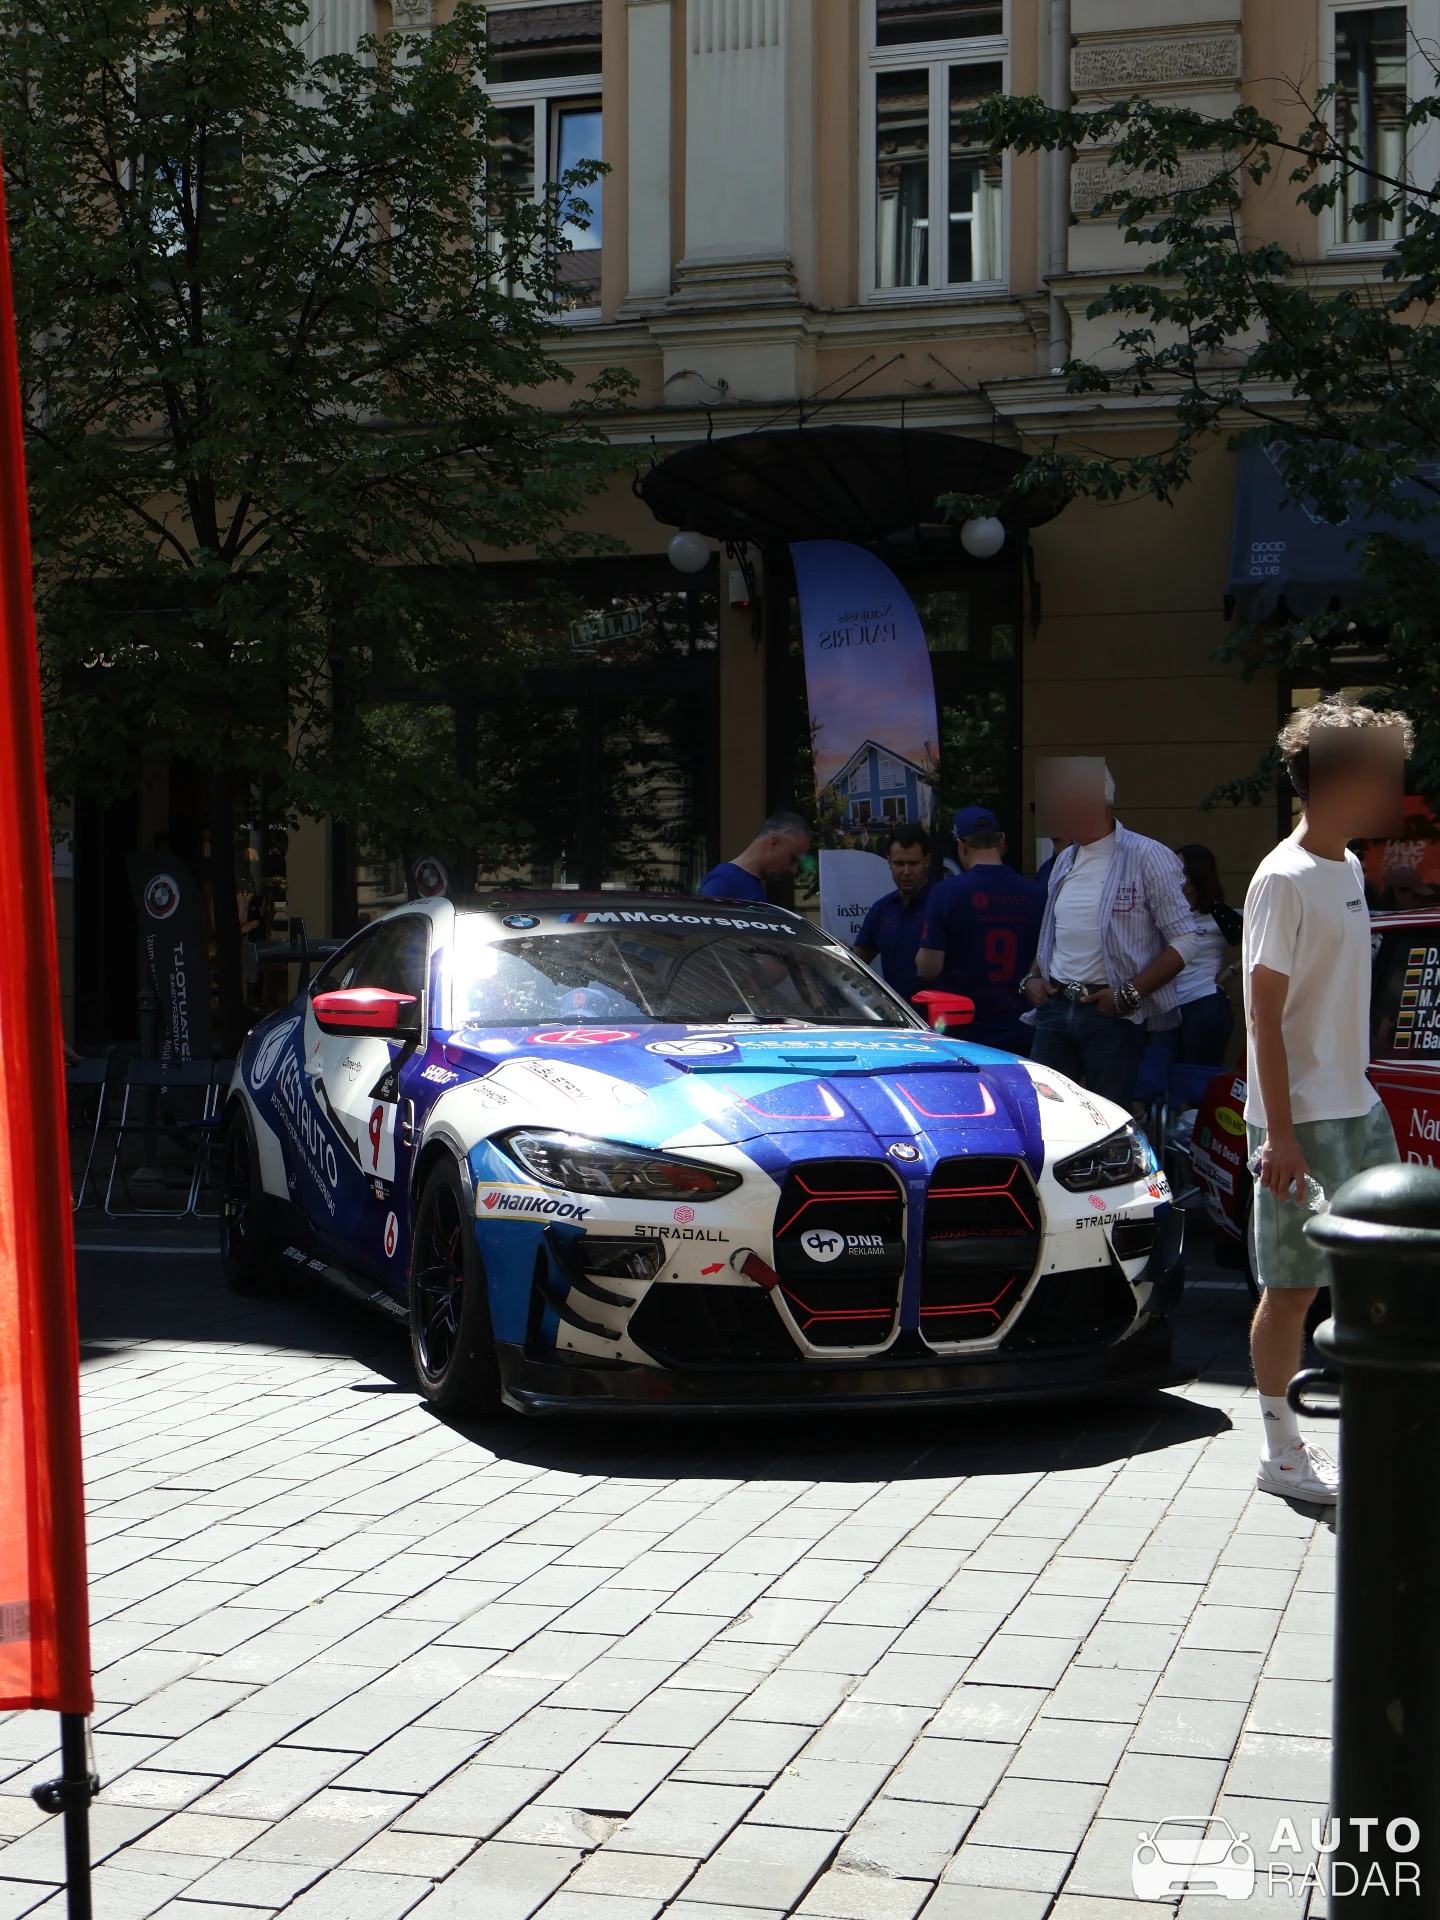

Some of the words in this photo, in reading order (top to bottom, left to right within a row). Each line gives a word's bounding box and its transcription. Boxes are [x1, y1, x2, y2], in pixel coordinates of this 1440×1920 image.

[1251, 541, 1287, 552] GOOD
[1251, 553, 1281, 564] LUCK
[1250, 565, 1280, 576] CLUB
[620, 911, 797, 935] Motorsport
[984, 928, 1018, 982] 9
[572, 993, 586, 1009] 9
[276, 1043, 338, 1188] KESTAUTO
[368, 1105, 384, 1172] 9
[1076, 1212, 1131, 1229] STRADALL
[386, 1214, 395, 1255] 6
[635, 1225, 730, 1242] STRADALL
[846, 1235, 883, 1247] DNR
[848, 1247, 885, 1256] REKLAMA
